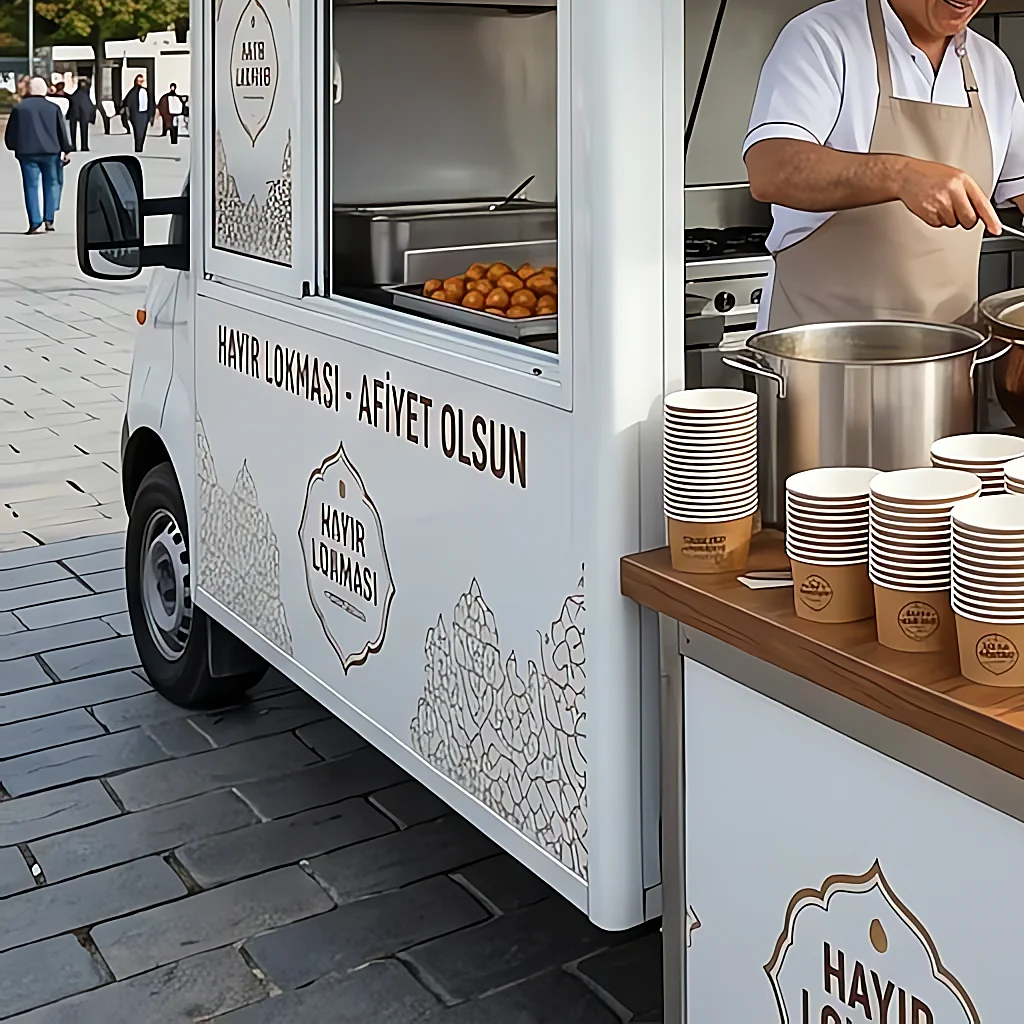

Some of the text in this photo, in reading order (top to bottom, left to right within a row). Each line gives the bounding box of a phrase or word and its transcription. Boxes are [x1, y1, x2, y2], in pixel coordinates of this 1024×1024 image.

[218, 324, 260, 379] HAYIR
[265, 340, 339, 412] LOKMASI
[358, 371, 433, 449] AFİYET
[441, 403, 527, 489] OLSUN
